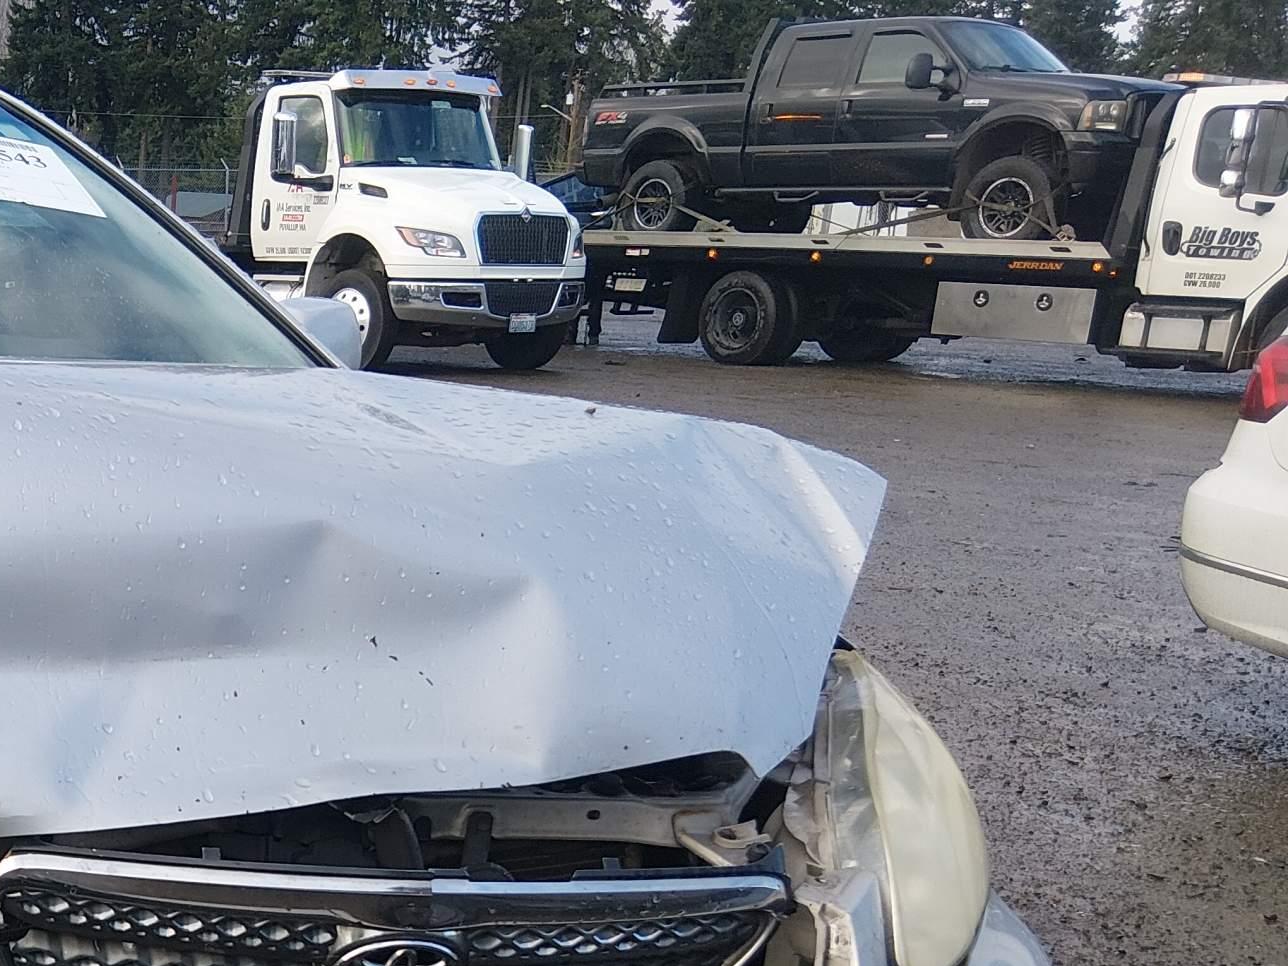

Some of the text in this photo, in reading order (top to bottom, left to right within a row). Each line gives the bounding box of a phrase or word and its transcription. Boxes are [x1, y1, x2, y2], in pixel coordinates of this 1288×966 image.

[597, 111, 627, 120] FX4
[1188, 226, 1259, 247] Big Boys
[1188, 246, 1257, 259] Towing
[1184, 271, 1197, 279] DOT
